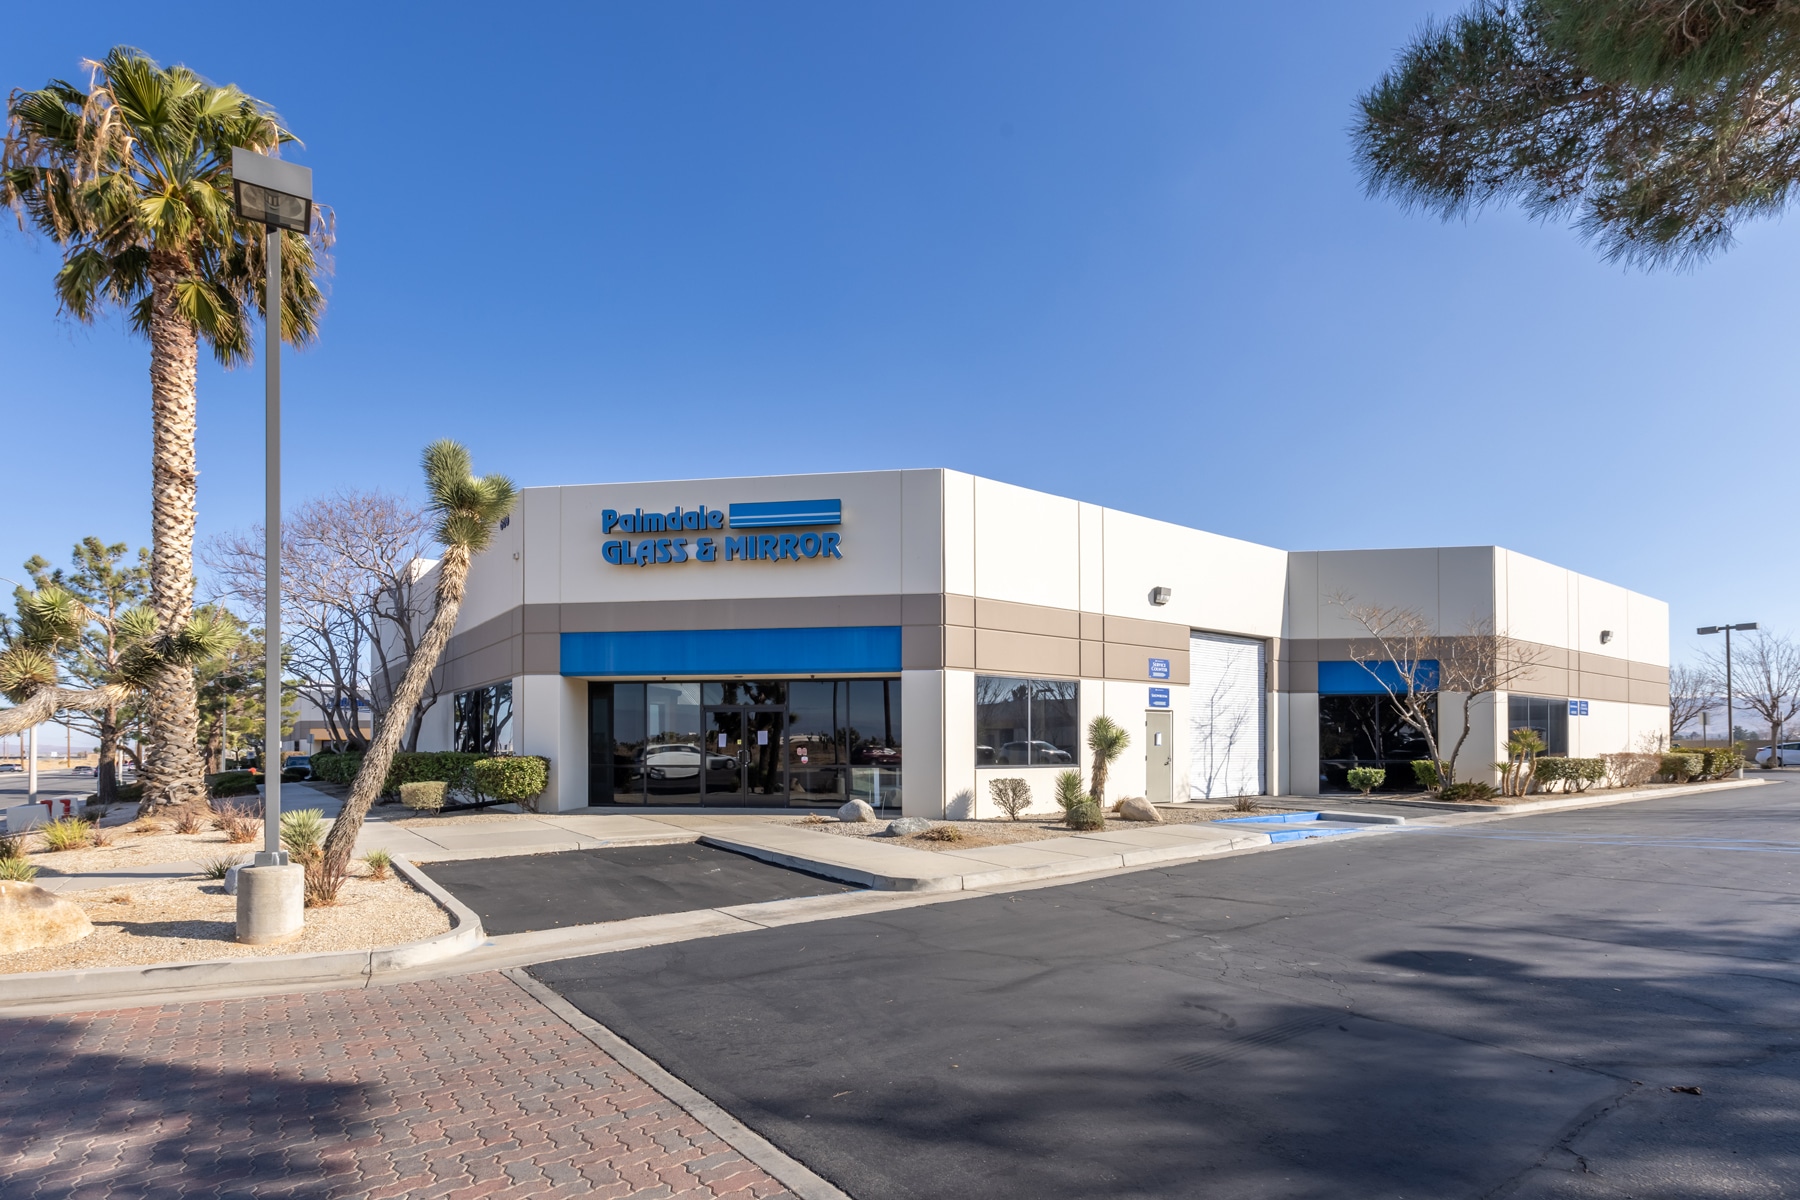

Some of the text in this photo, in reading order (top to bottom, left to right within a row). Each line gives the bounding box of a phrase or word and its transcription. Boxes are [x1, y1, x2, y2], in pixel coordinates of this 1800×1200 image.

[602, 505, 724, 534] Palmdale
[602, 532, 843, 567] GLASS & MIRROR
